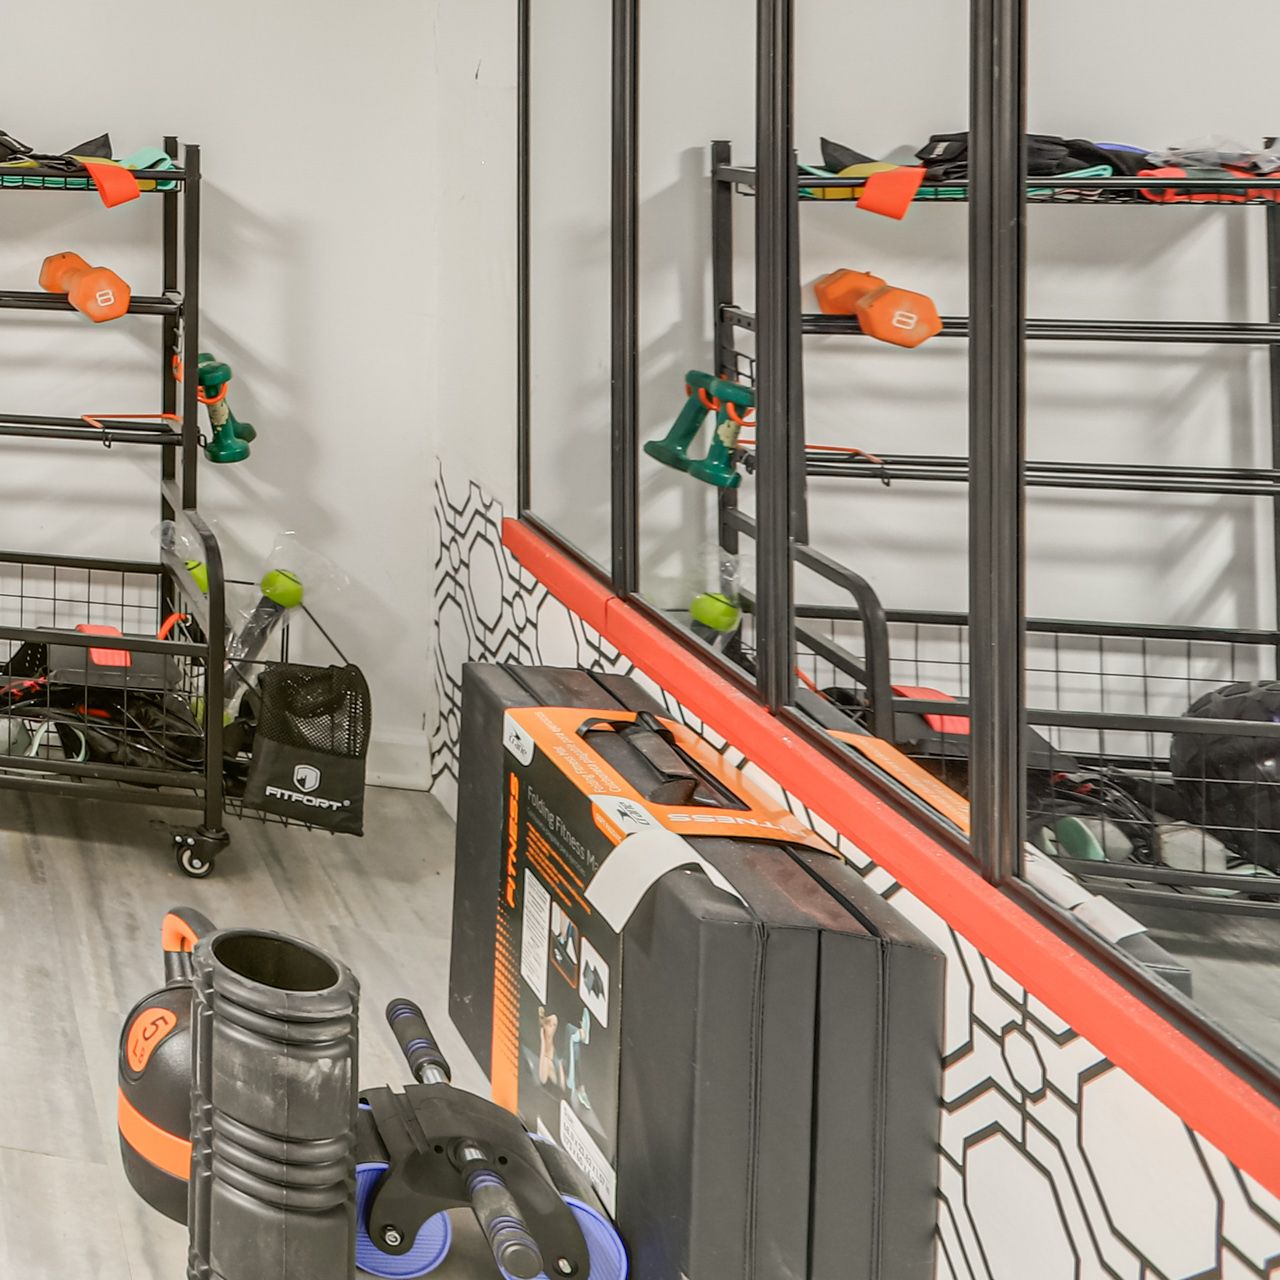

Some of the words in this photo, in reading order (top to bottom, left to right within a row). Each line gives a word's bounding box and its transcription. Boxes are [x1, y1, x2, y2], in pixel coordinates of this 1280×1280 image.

[96, 289, 115, 307] 8
[265, 785, 343, 811] FITFORT
[526, 785, 556, 832] Folding
[555, 816, 585, 860] Fitness
[142, 1015, 169, 1042] 5
